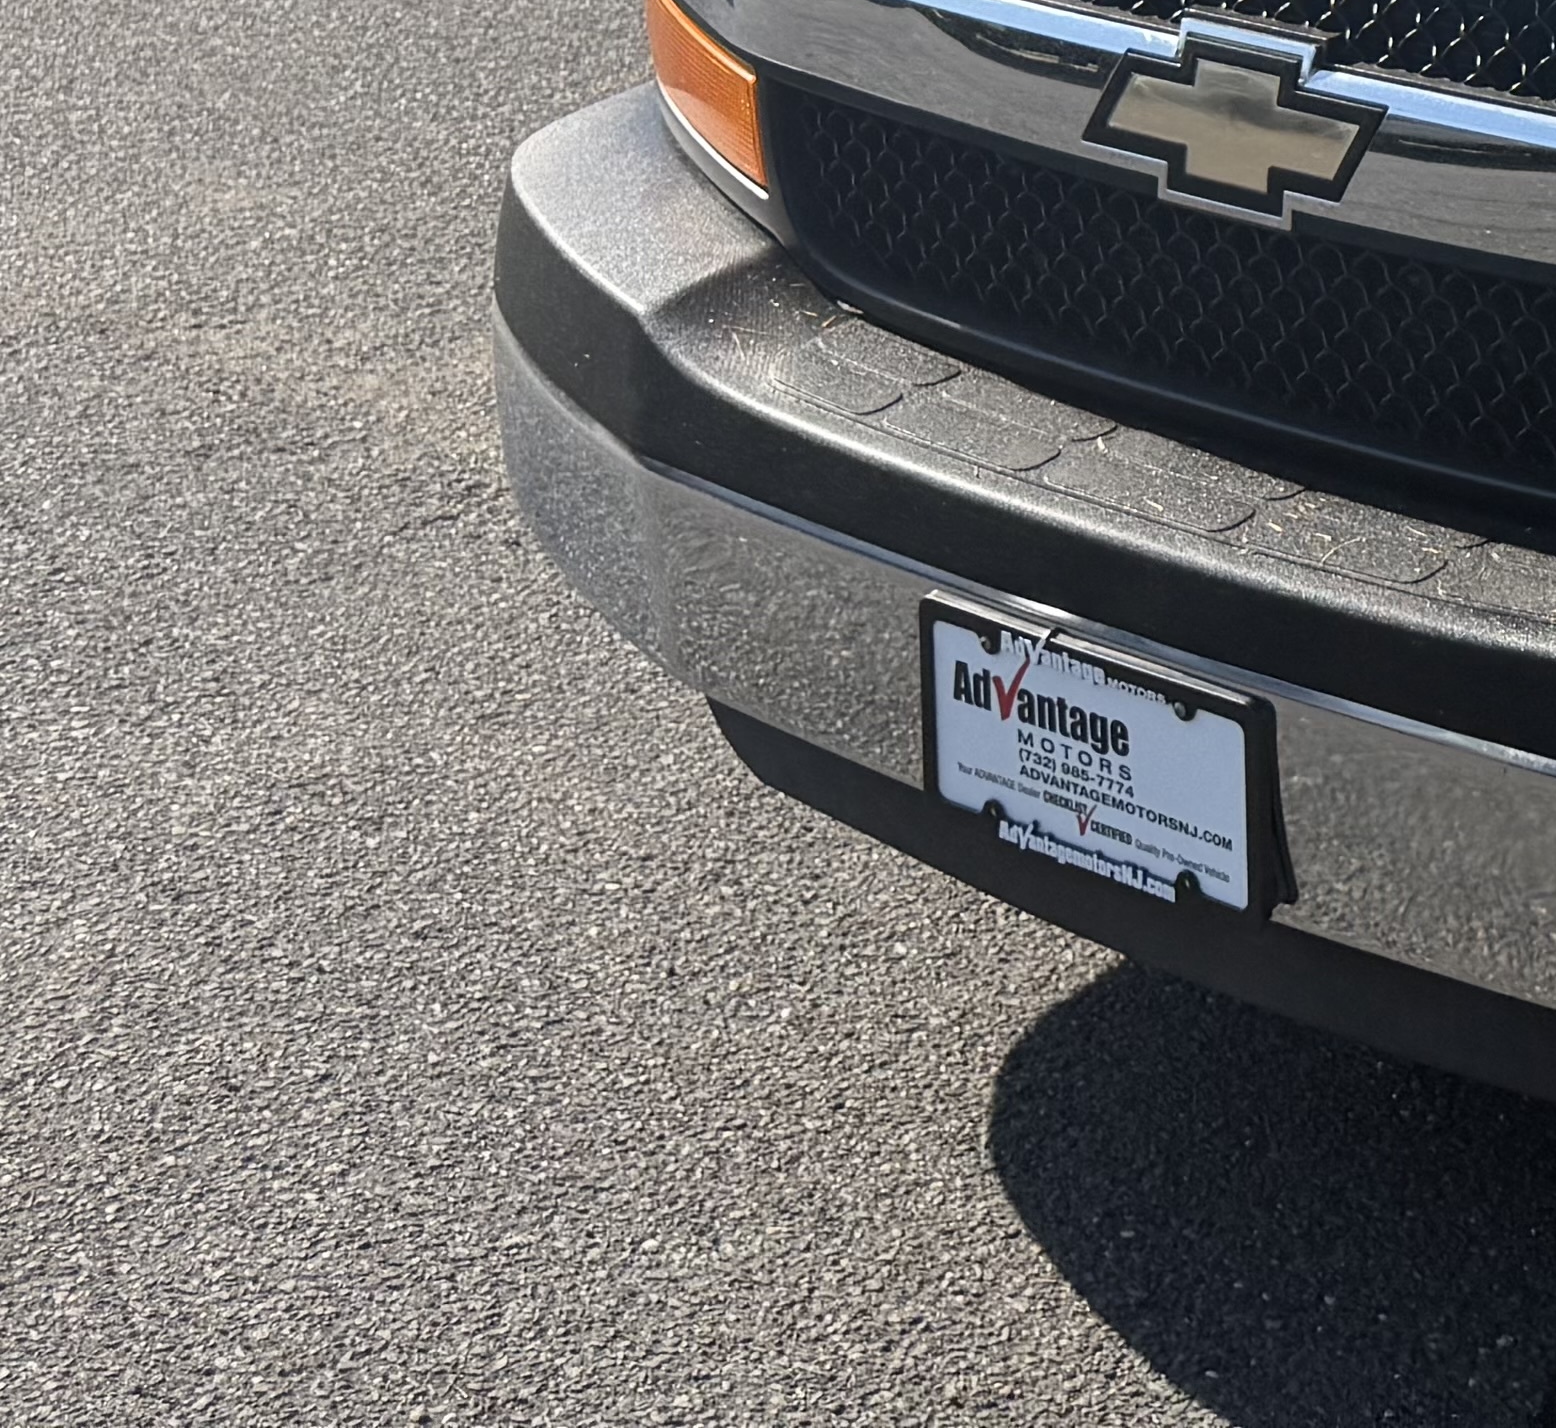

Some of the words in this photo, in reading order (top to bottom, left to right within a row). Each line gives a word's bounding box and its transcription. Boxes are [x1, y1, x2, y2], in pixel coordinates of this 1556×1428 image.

[1017, 728, 1133, 782] MOTORS
[1019, 748, 1057, 773] (732)
[1060, 762, 1135, 799] 985-7774
[1019, 764, 1234, 852] ADVANTAGEMOTORSNJ.COM
